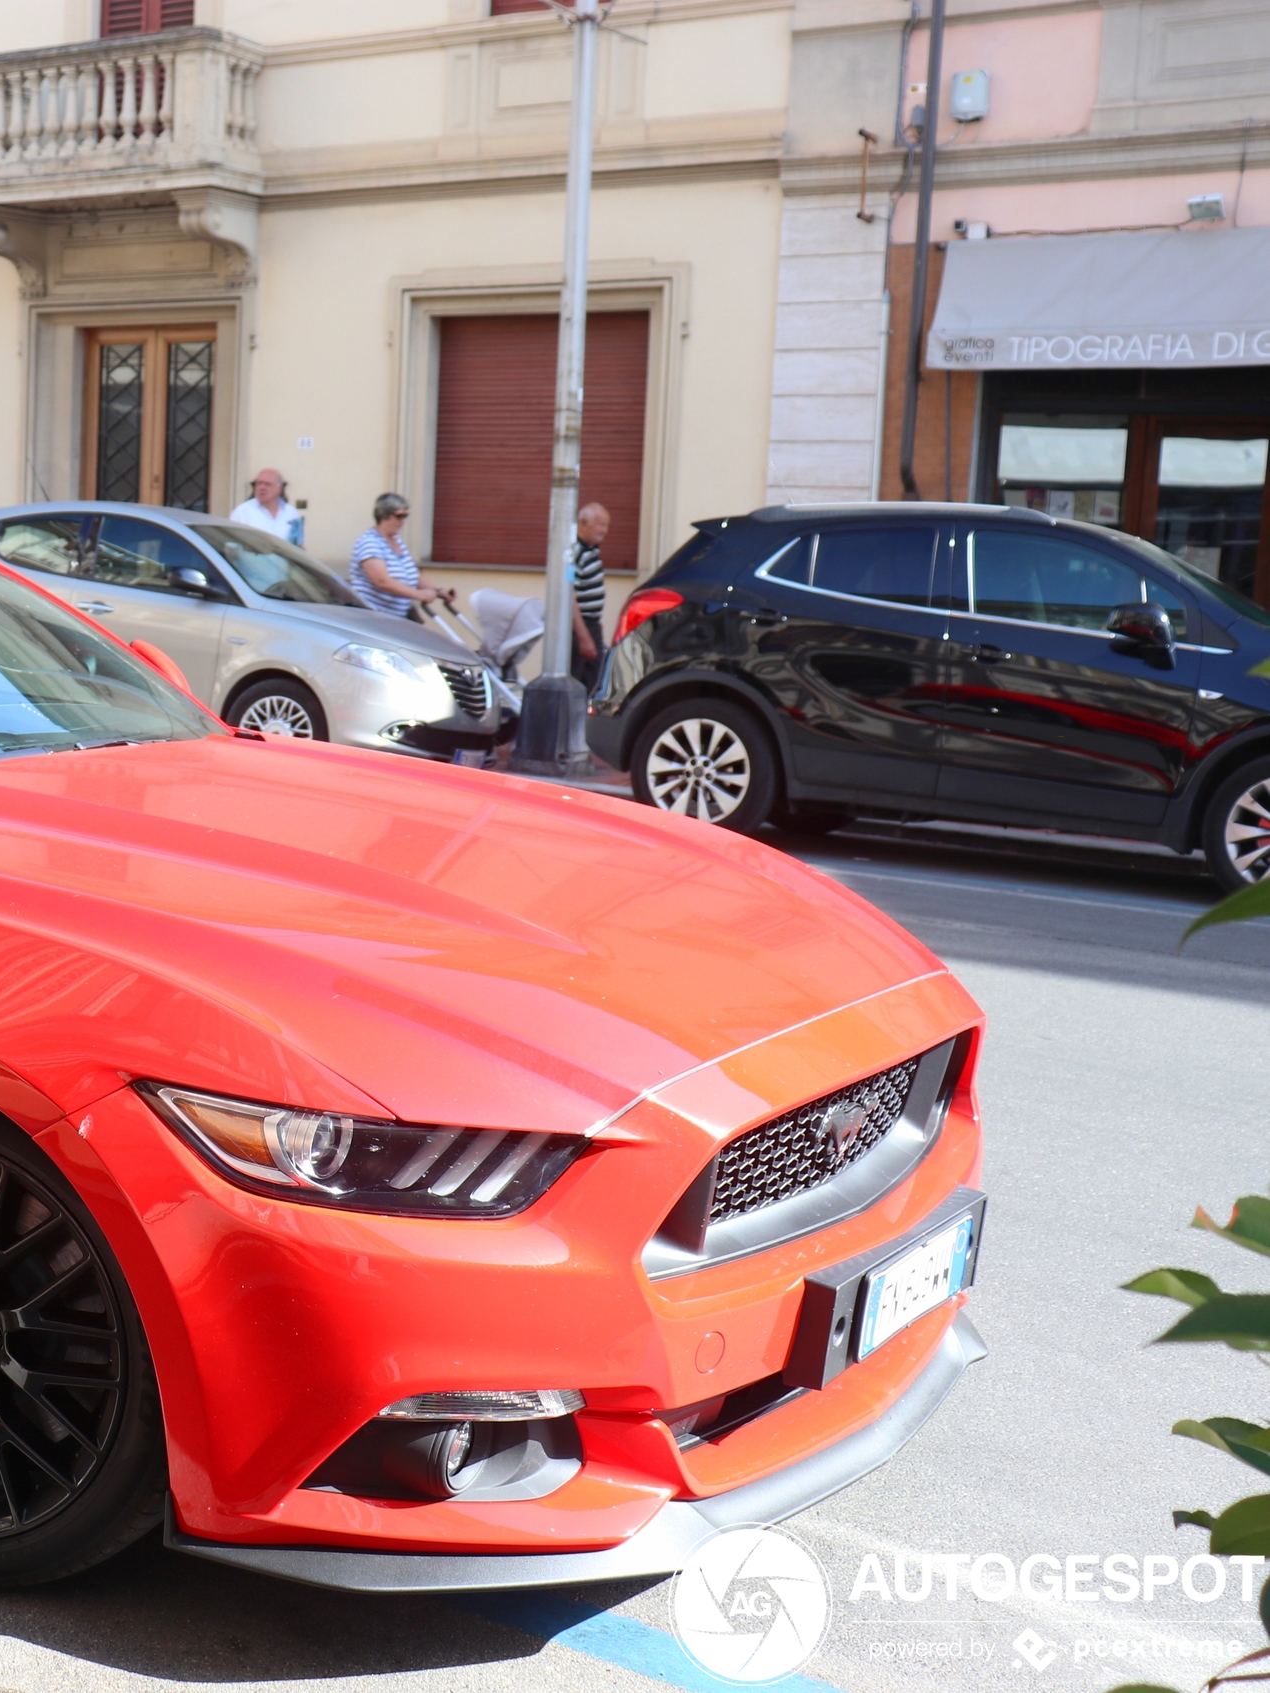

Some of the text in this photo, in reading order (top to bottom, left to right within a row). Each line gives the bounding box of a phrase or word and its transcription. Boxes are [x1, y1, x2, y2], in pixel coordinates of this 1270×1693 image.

[944, 337, 995, 351] grafica
[1009, 334, 1195, 362] TIPOGRAFIA
[1212, 331, 1245, 359] DI
[944, 349, 995, 363] eventi
